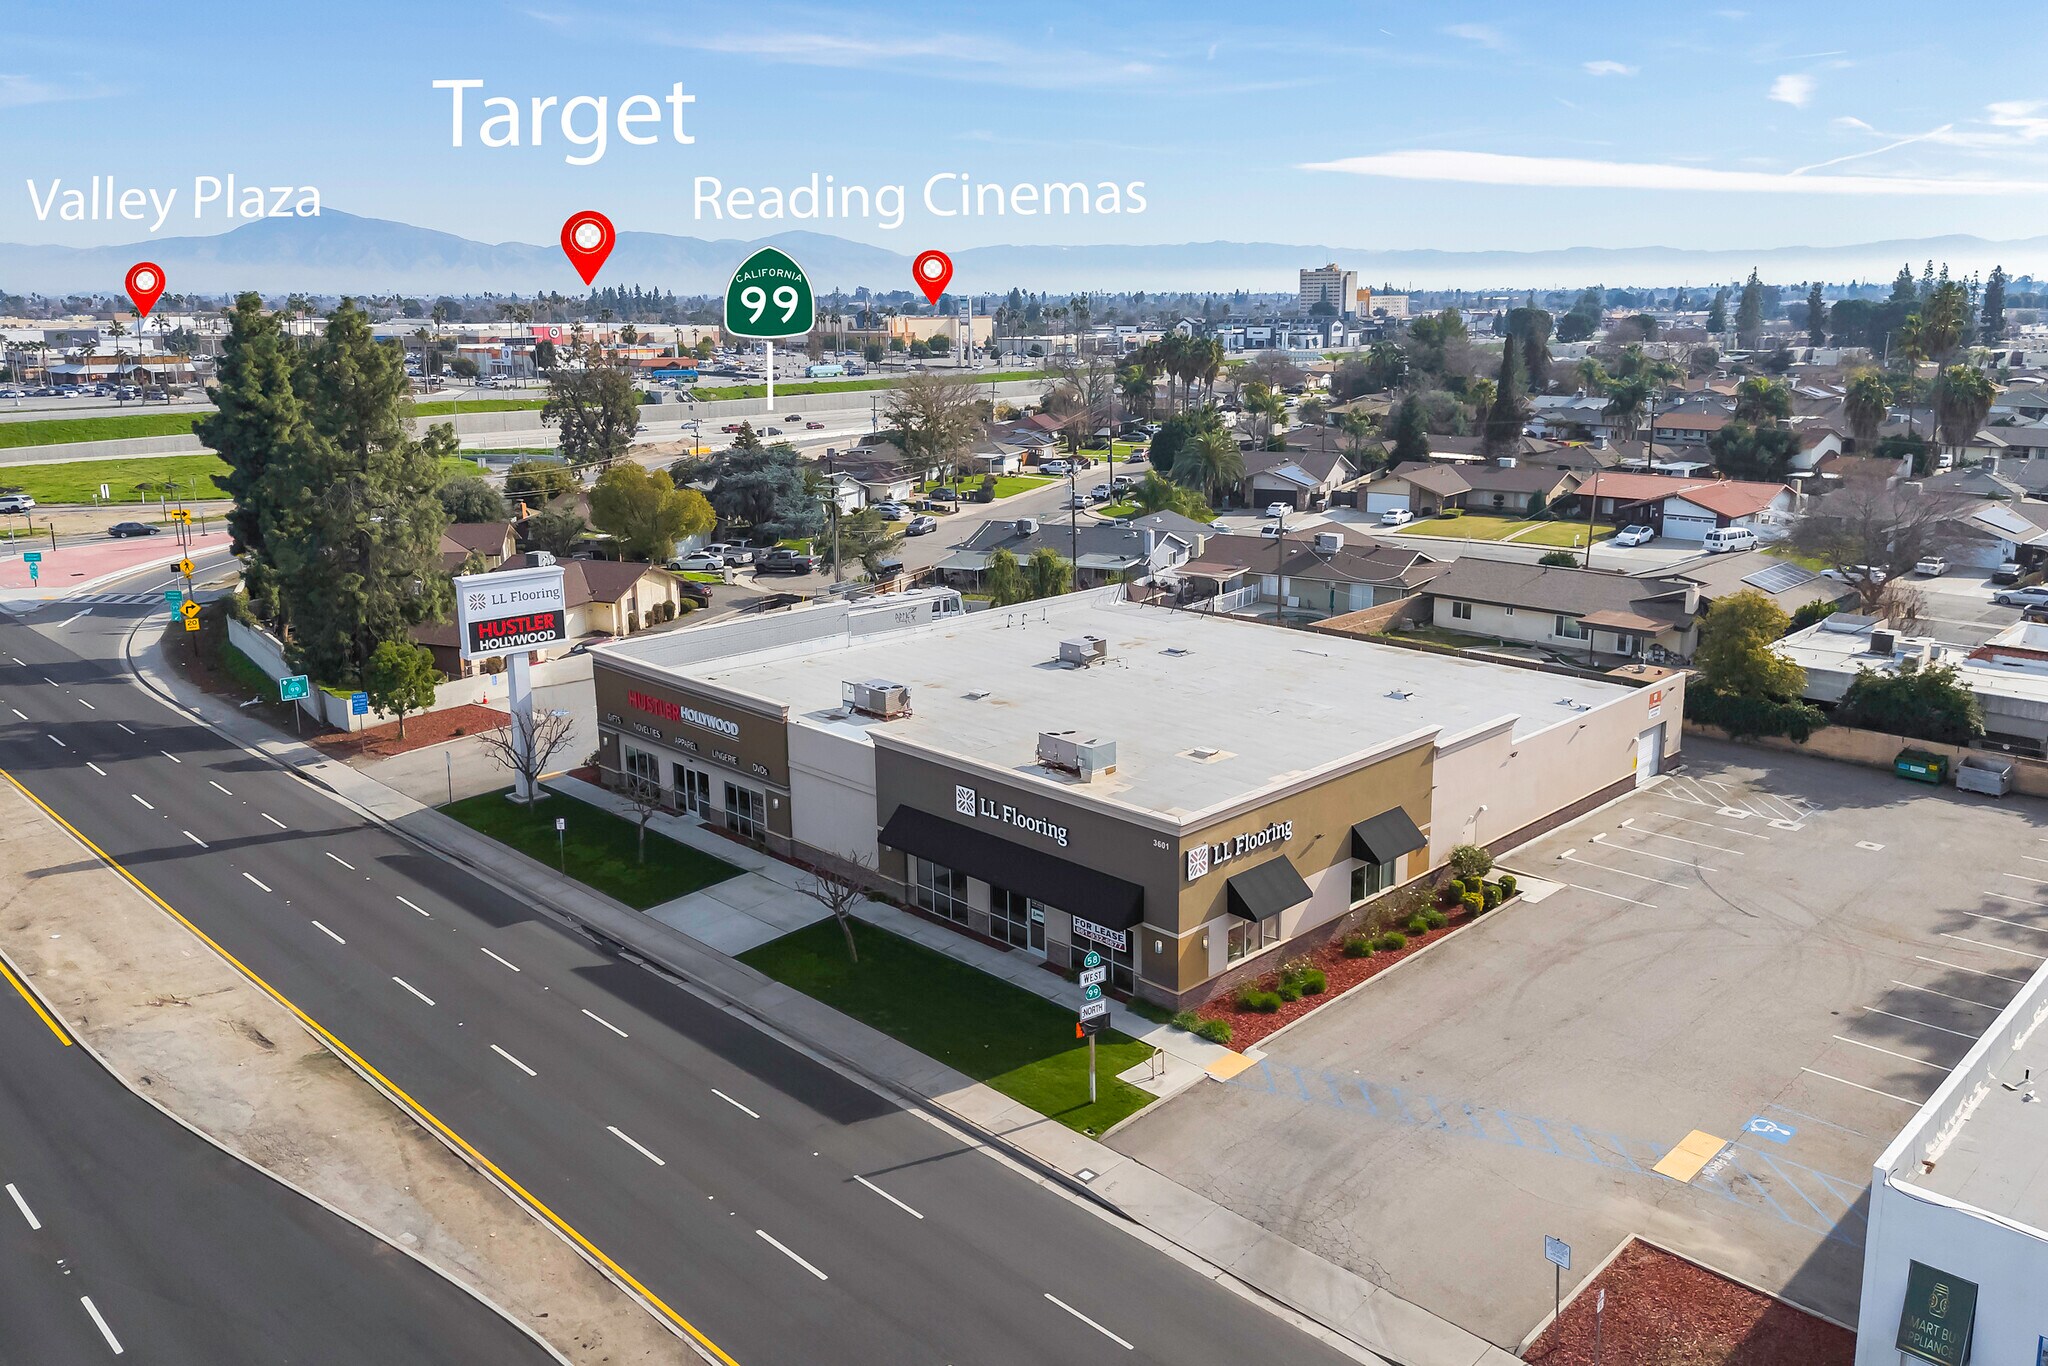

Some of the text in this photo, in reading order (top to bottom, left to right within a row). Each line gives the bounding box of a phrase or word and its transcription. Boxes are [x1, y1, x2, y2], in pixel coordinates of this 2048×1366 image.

[491, 588, 561, 605] LL Flooring
[478, 613, 555, 639] HUSTLER
[480, 630, 556, 651] HOLLYWOOD
[607, 712, 622, 724] GIFTS
[628, 689, 740, 737] HUSTLER HOLLYWOOD
[633, 722, 661, 739] NOVELTIES
[674, 736, 698, 752] APPAREL
[711, 749, 738, 765] LINGERIE
[752, 762, 769, 776] DVDs
[980, 797, 1068, 847] LL Flooring
[1152, 839, 1170, 851] 3601
[1213, 820, 1293, 865] LL Flooring
[1074, 917, 1125, 943] FOR LEASE
[1087, 955, 1098, 965] 58
[1083, 970, 1103, 983] WEST
[1088, 988, 1099, 998] 99
[1082, 1003, 1103, 1017] NORTH
[1905, 1313, 1940, 1337] MART
[1903, 1329, 1955, 1360] PPLIANCE
